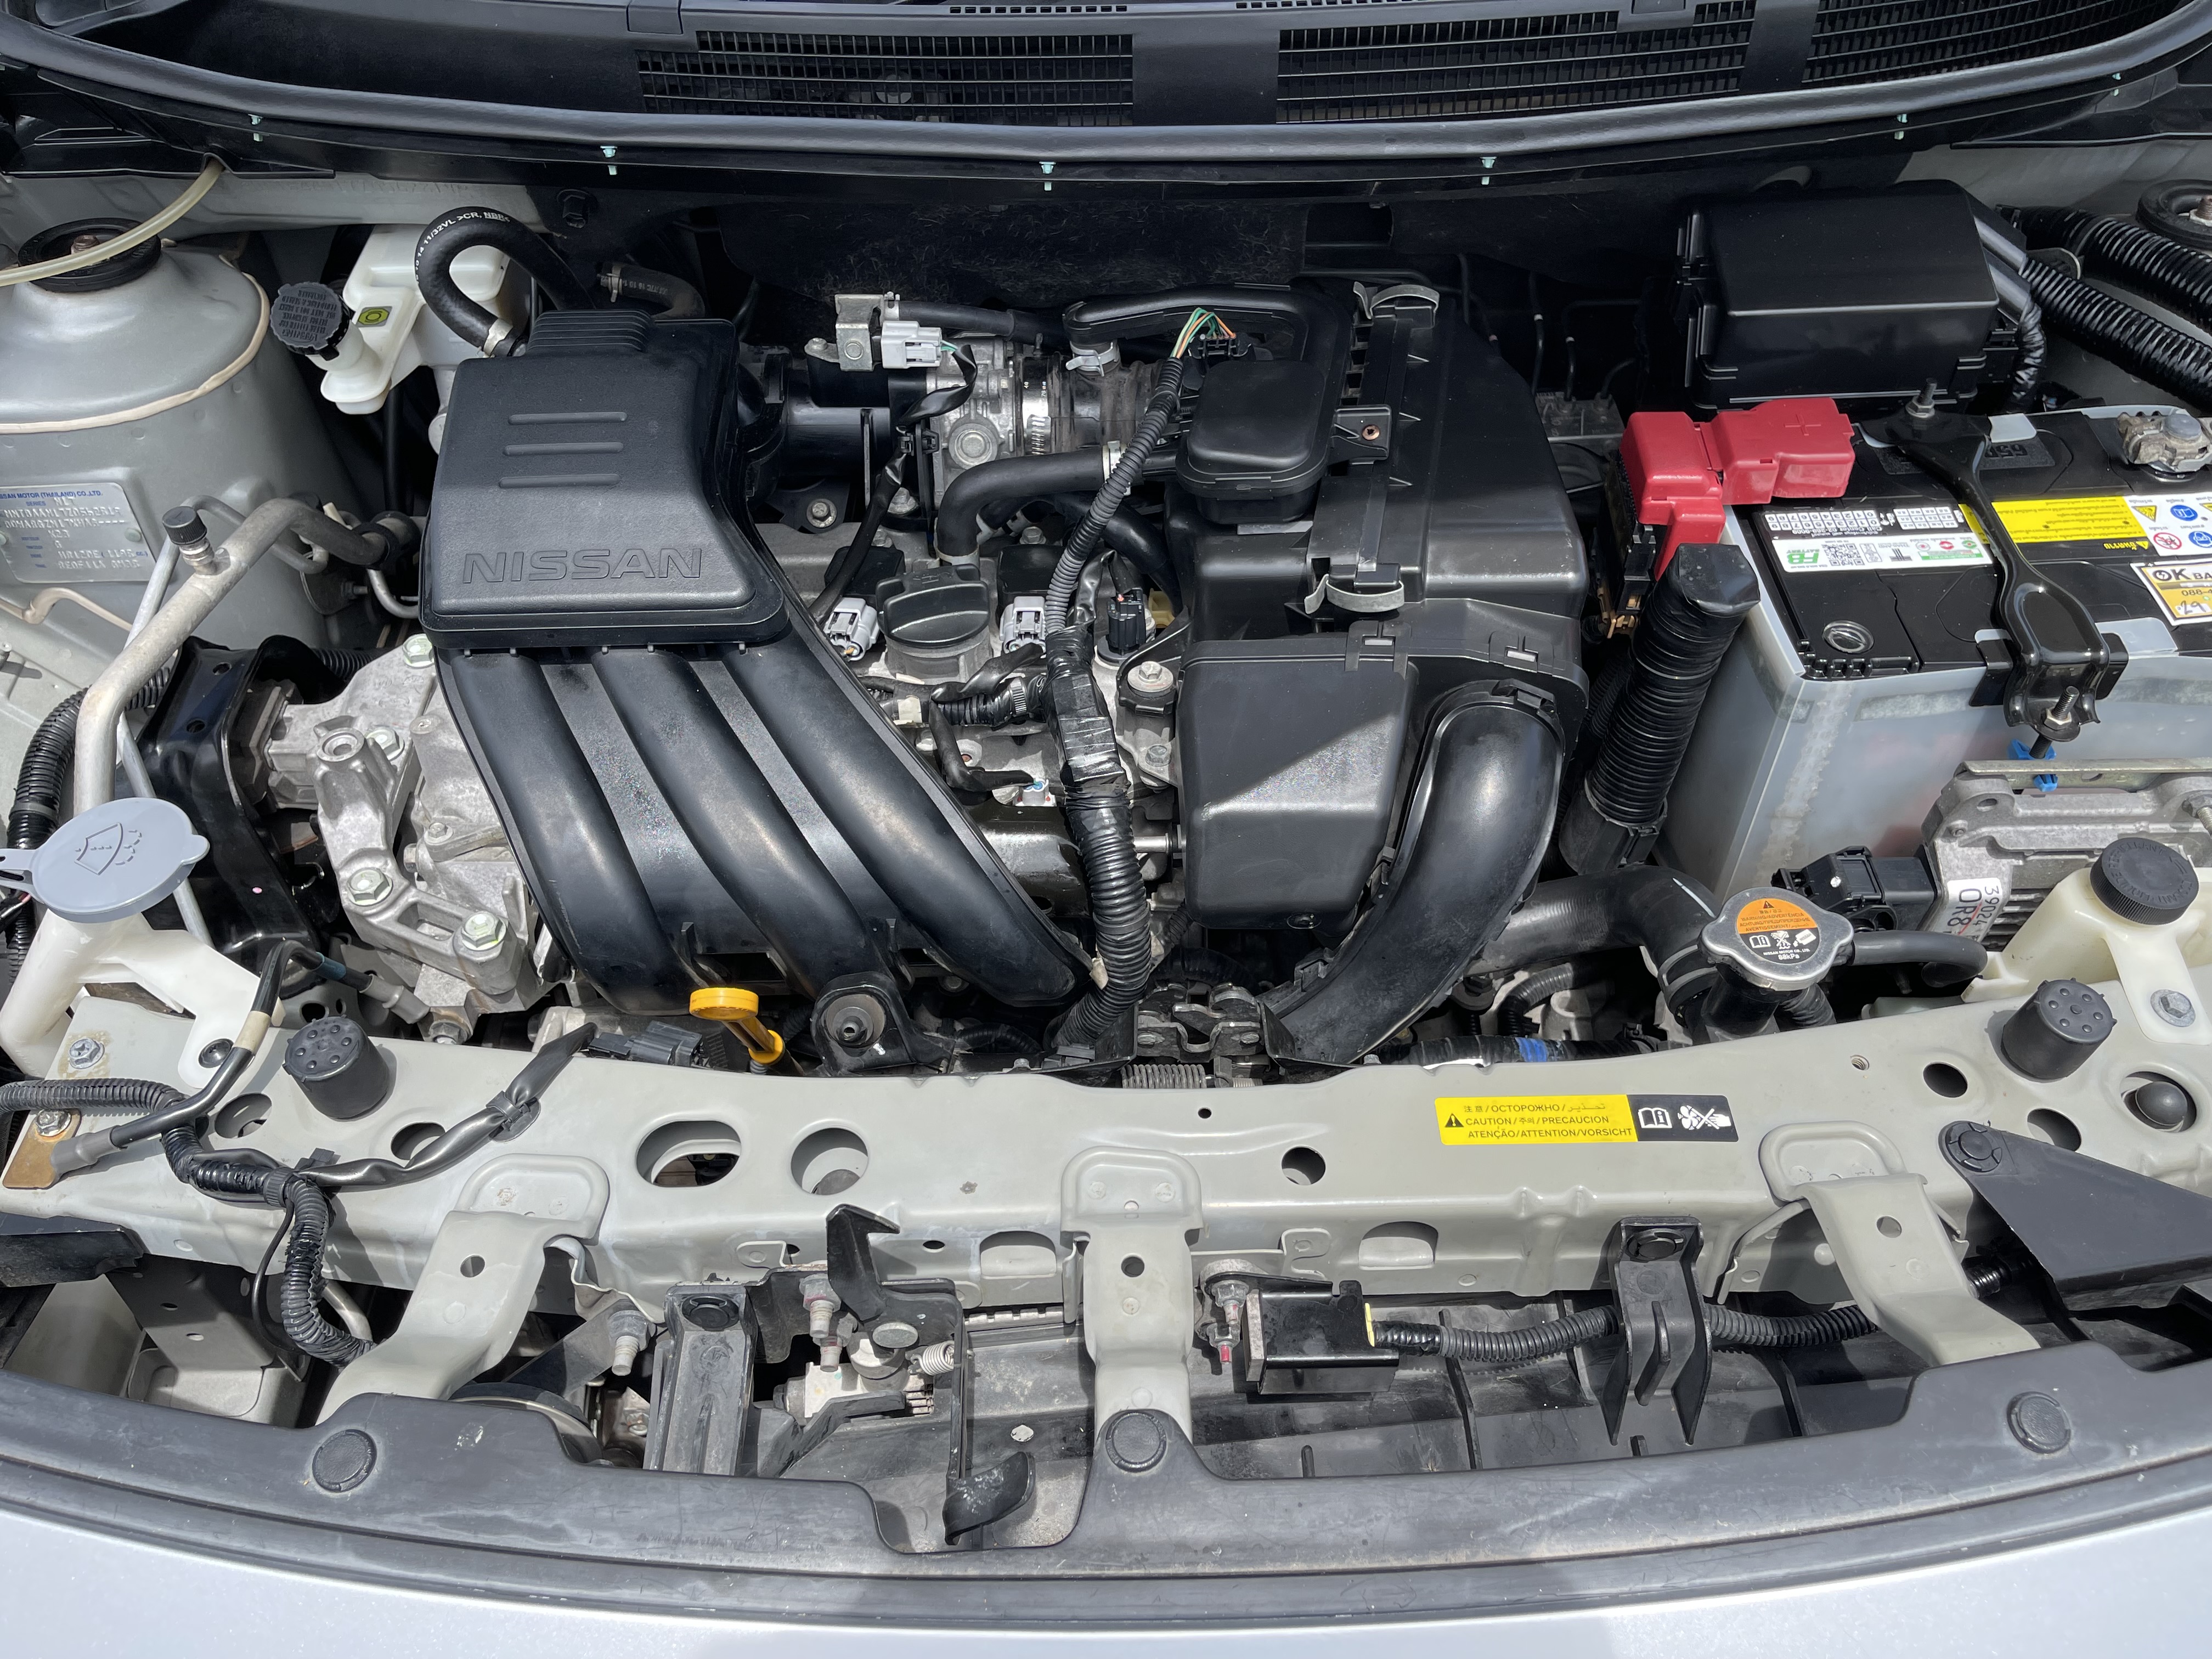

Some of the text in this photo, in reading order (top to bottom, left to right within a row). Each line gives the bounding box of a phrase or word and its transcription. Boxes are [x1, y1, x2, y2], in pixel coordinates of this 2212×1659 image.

[417, 246, 425, 257] 14
[424, 219, 456, 245] 11/32VL
[456, 212, 482, 221] >CR,
[41, 490, 76, 499] (THAILAND)
[48, 529, 70, 538] K23
[1786, 552, 1820, 565] FB
[462, 548, 703, 584] NISSAN
[2152, 568, 2192, 582] OK
[1491, 1104, 1560, 1113] ОСТОРОЖНО
[1465, 1117, 1512, 1126] CAUTION
[1542, 1115, 1609, 1124] PRECAUCION
